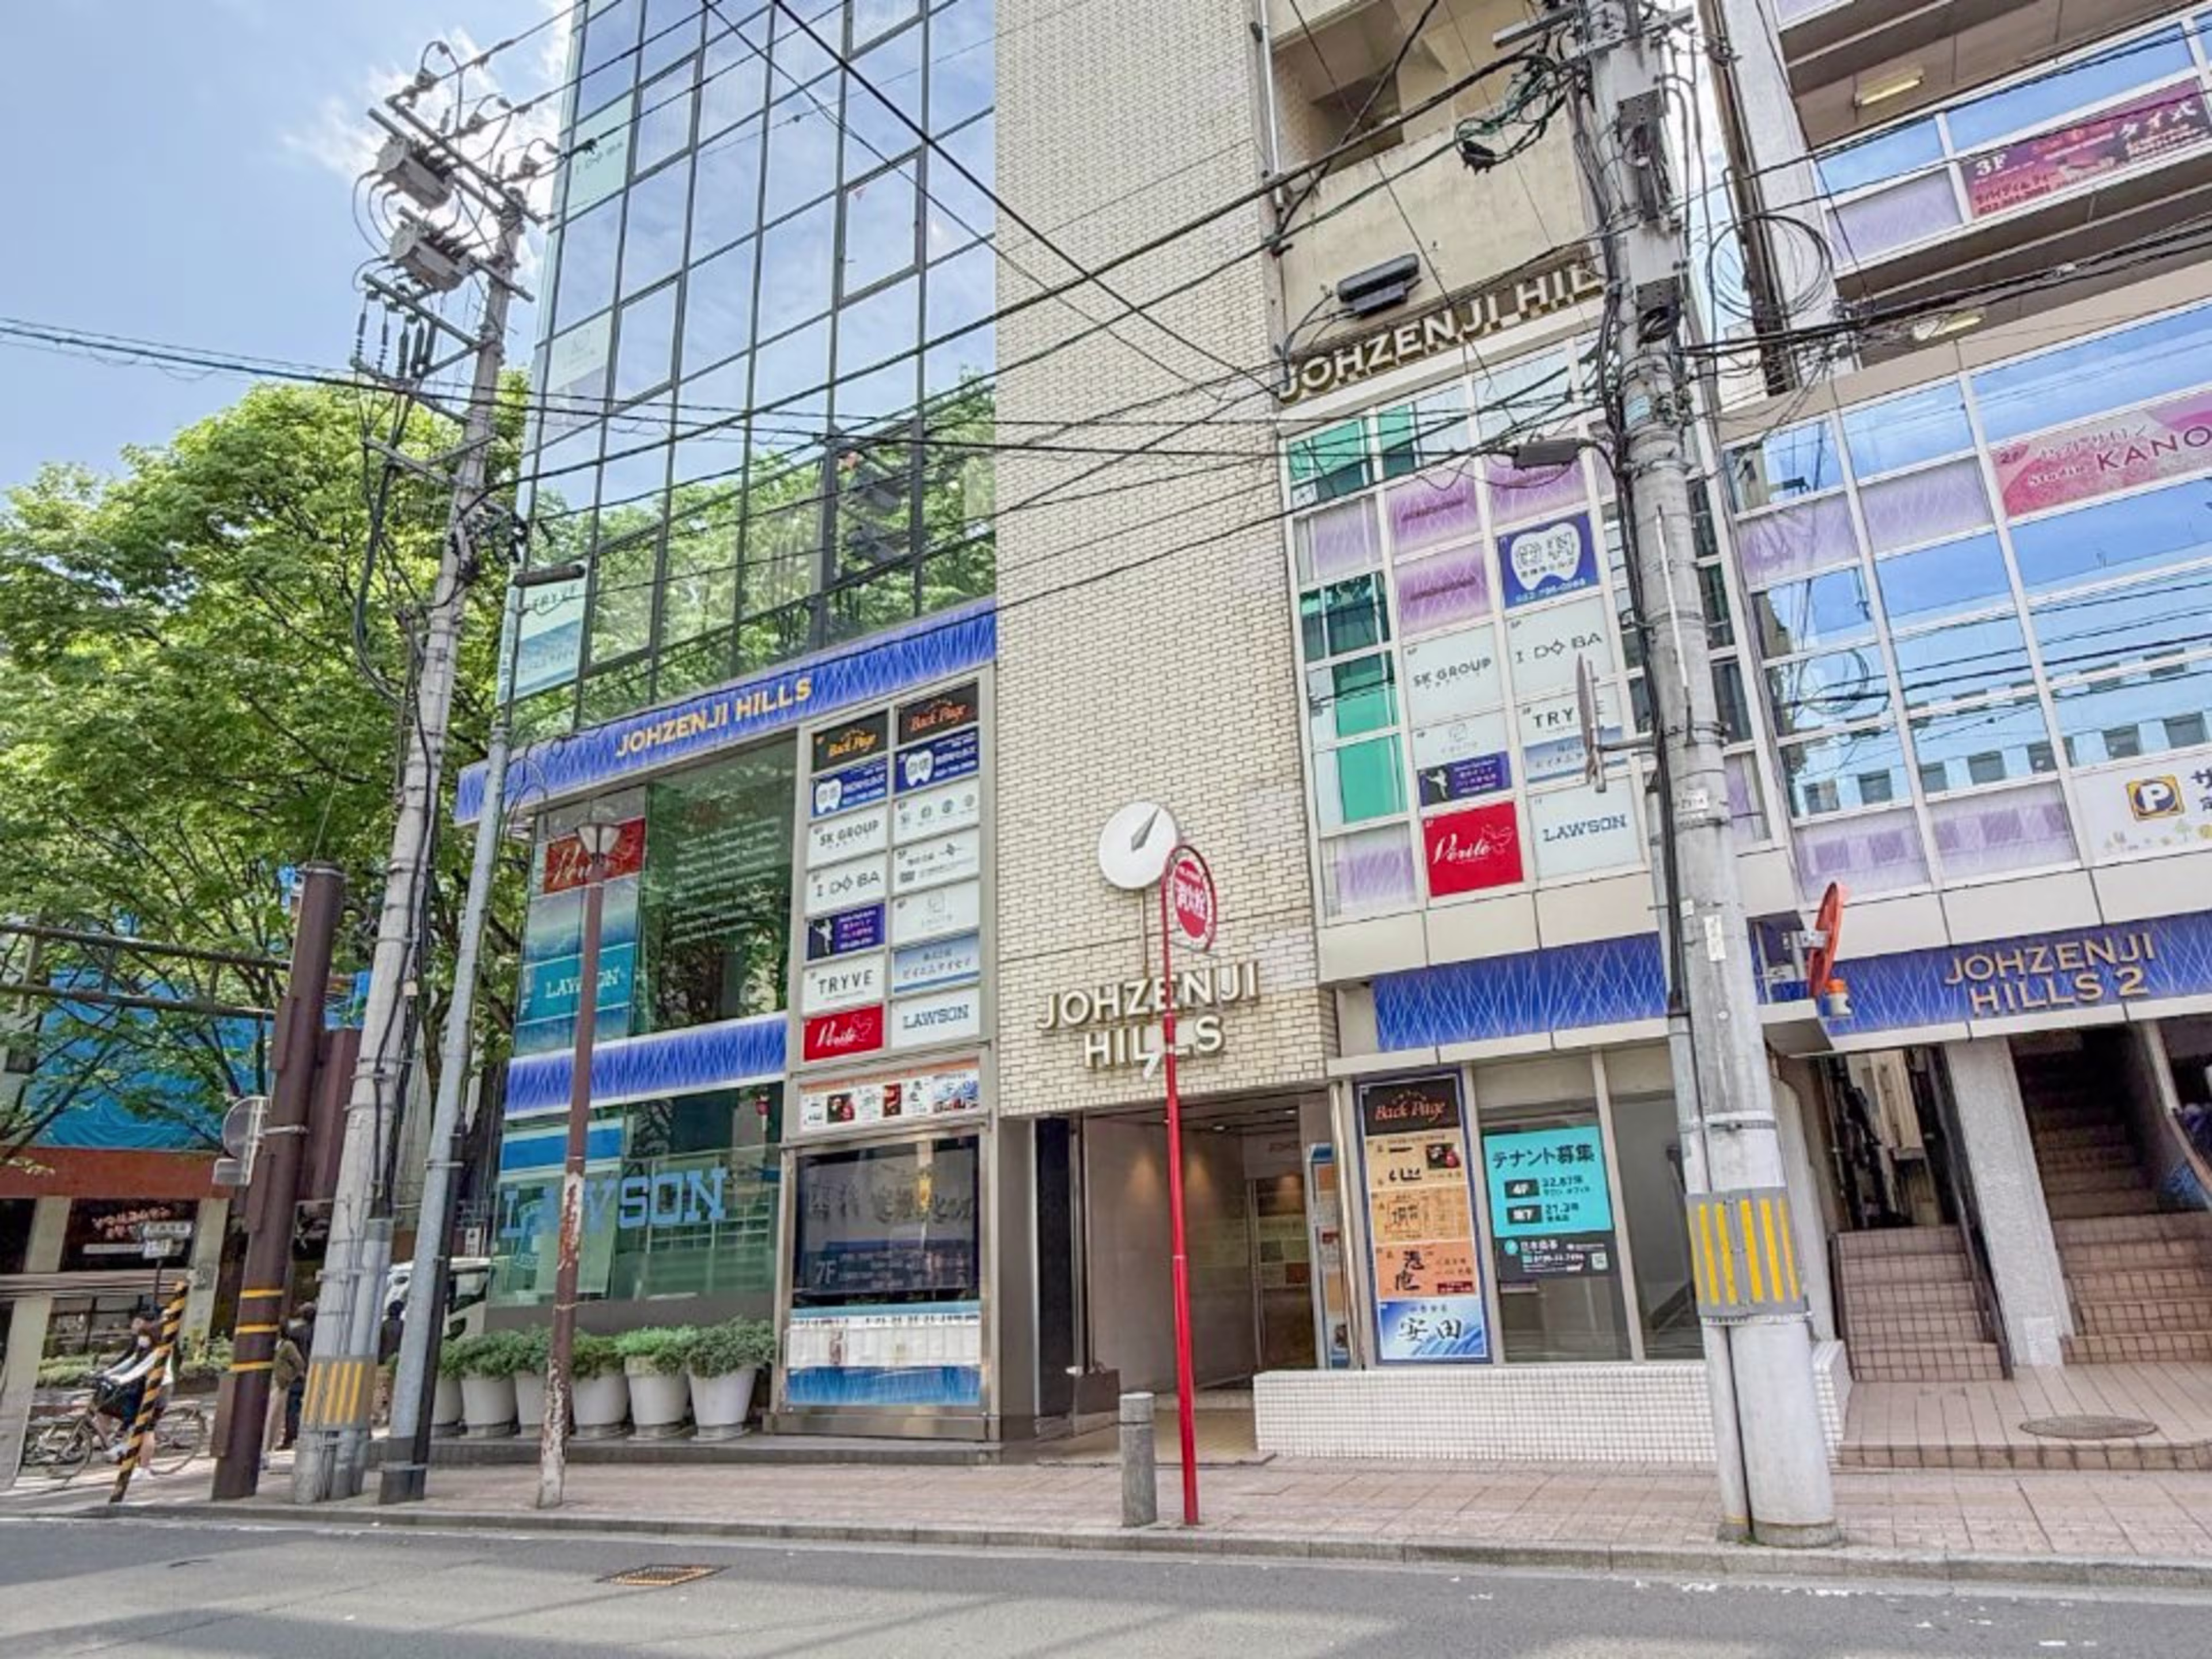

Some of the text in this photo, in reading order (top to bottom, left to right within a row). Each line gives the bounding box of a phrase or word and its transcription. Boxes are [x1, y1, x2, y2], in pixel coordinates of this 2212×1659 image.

[1975, 154, 2008, 176] 3F
[1279, 264, 1603, 399] JOHZENJI HIL
[1413, 671, 1431, 687] SK
[1437, 657, 1492, 680] GROUP
[615, 677, 812, 757] JOHZENJI HILLS
[1533, 699, 1605, 728] TRYE
[820, 819, 880, 847] SK GROUP
[1543, 813, 1627, 842] LAWSON
[1945, 932, 2156, 985] JOHZENJI
[817, 969, 874, 995] TRYVE
[1037, 960, 1259, 1031] JOHZENJI
[1969, 966, 2150, 1015] HILLS 2
[902, 1004, 970, 1030] LAWSON
[1375, 1100, 1446, 1123] Back Page
[1492, 1143, 1596, 1169] テナント募集
